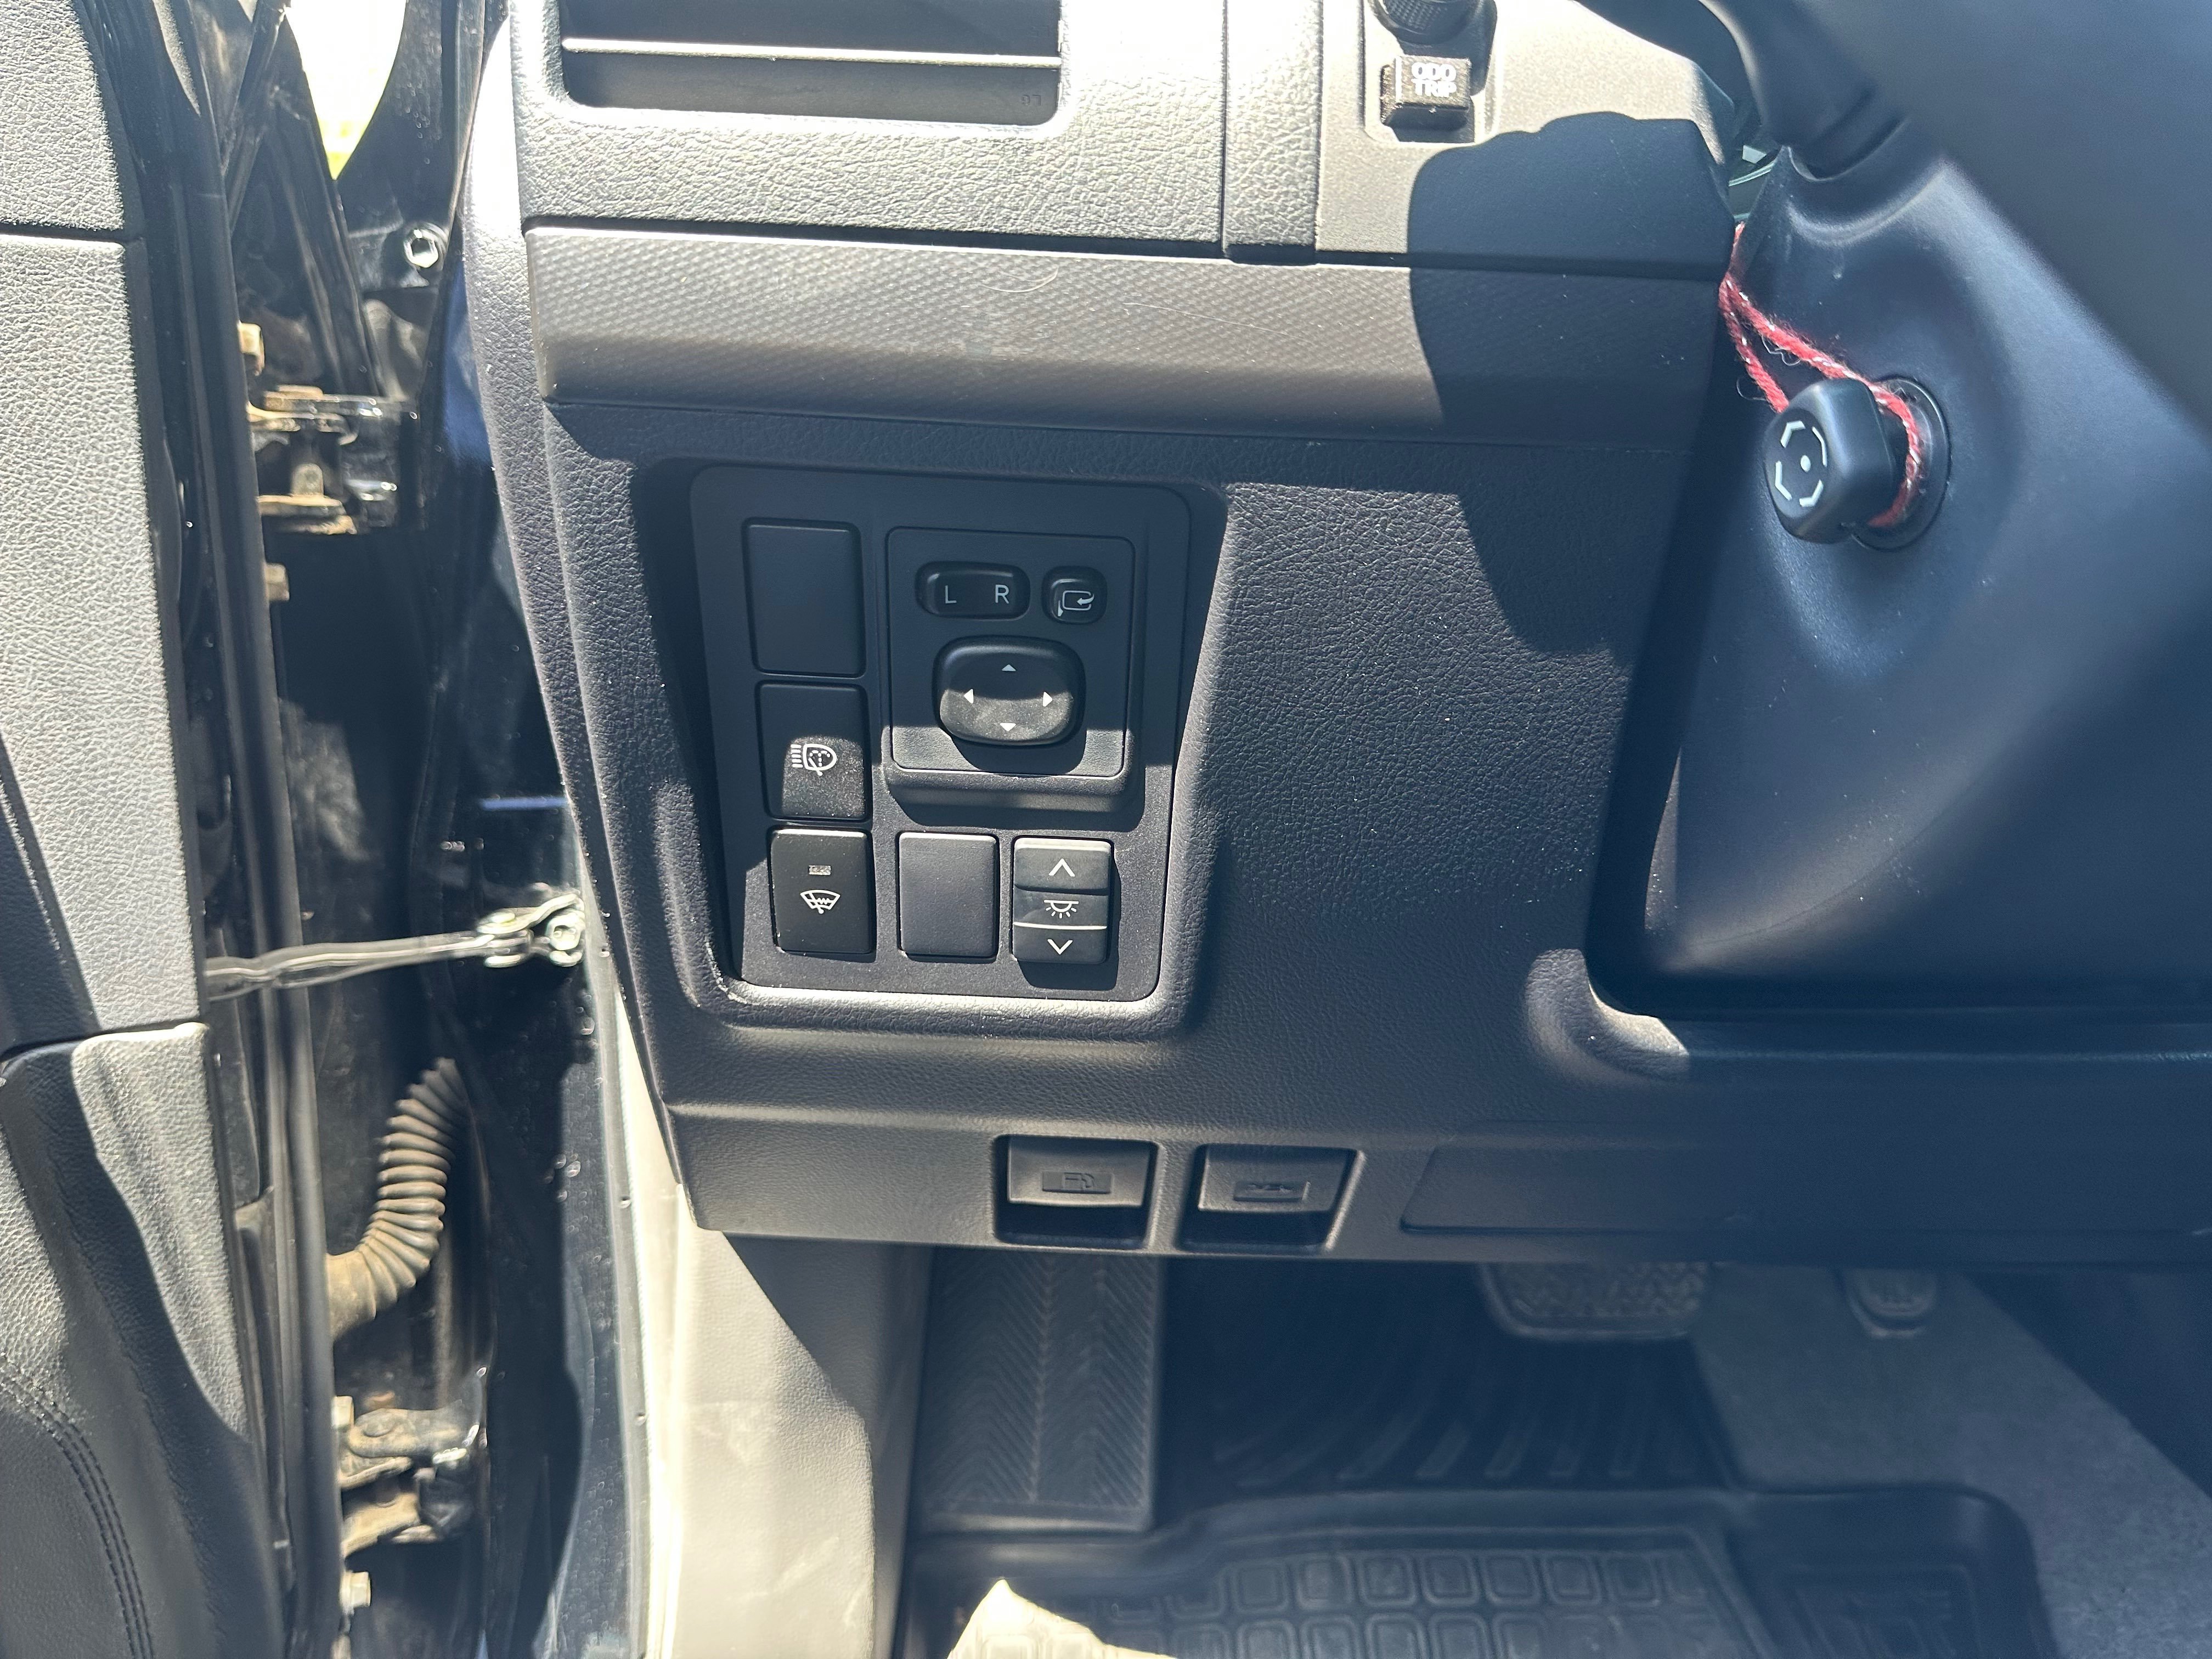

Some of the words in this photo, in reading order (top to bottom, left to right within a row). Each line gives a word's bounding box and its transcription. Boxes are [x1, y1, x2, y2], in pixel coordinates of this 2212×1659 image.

[1411, 61, 1457, 82] ODO
[1411, 78, 1457, 98] TRIP
[945, 585, 957, 605] L
[995, 584, 1009, 604] R
